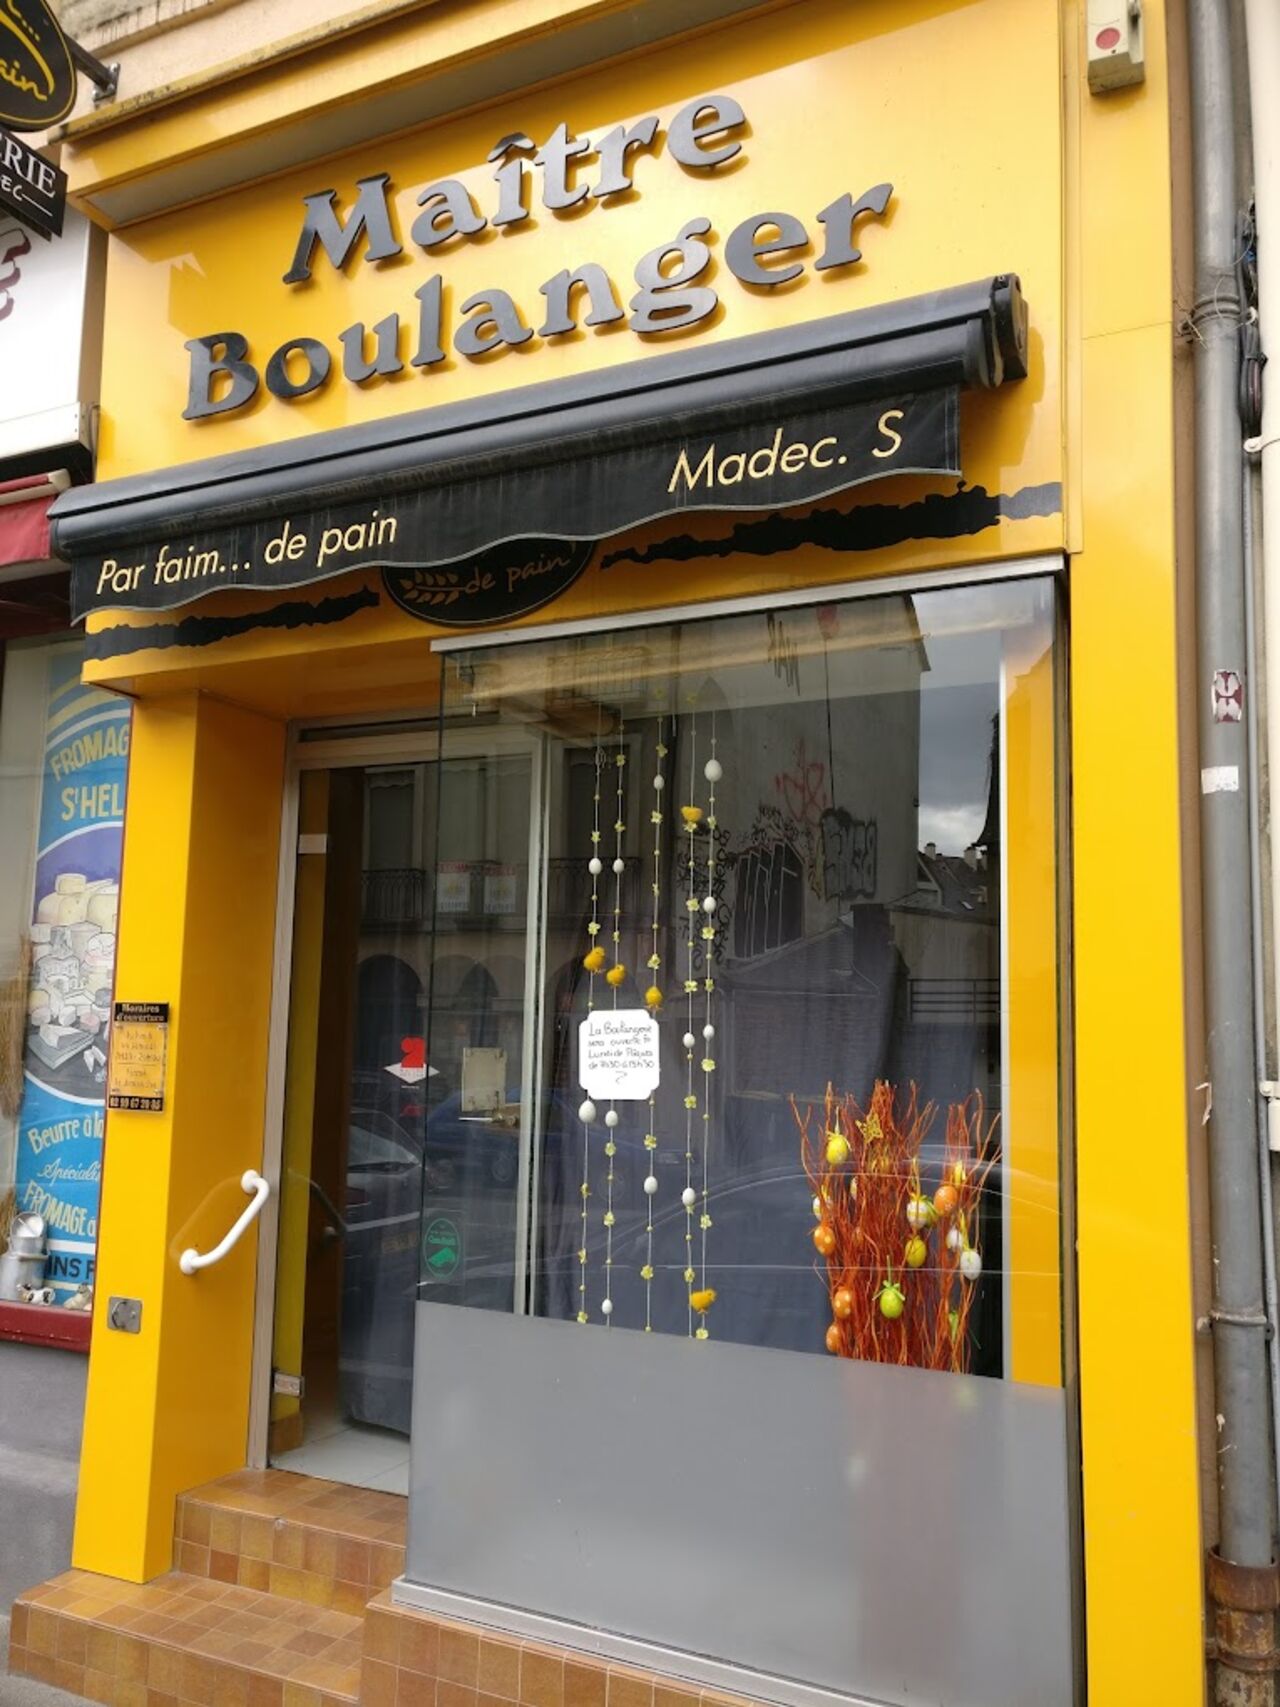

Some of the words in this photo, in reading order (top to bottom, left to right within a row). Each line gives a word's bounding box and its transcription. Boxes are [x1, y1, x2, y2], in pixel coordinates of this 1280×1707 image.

[0, 132, 56, 199] RIE
[282, 94, 746, 285] Maître
[182, 183, 894, 420] Boulanger
[667, 427, 848, 494] Madec.
[871, 409, 905, 458] S
[96, 559, 145, 595] Par
[153, 545, 251, 585] faim...
[264, 520, 307, 564] de
[316, 510, 398, 568] pain
[465, 567, 496, 594] de
[588, 1022, 602, 1036] La
[28, 1117, 80, 1154] Beurre
[23, 1180, 88, 1236] FROMAGE
